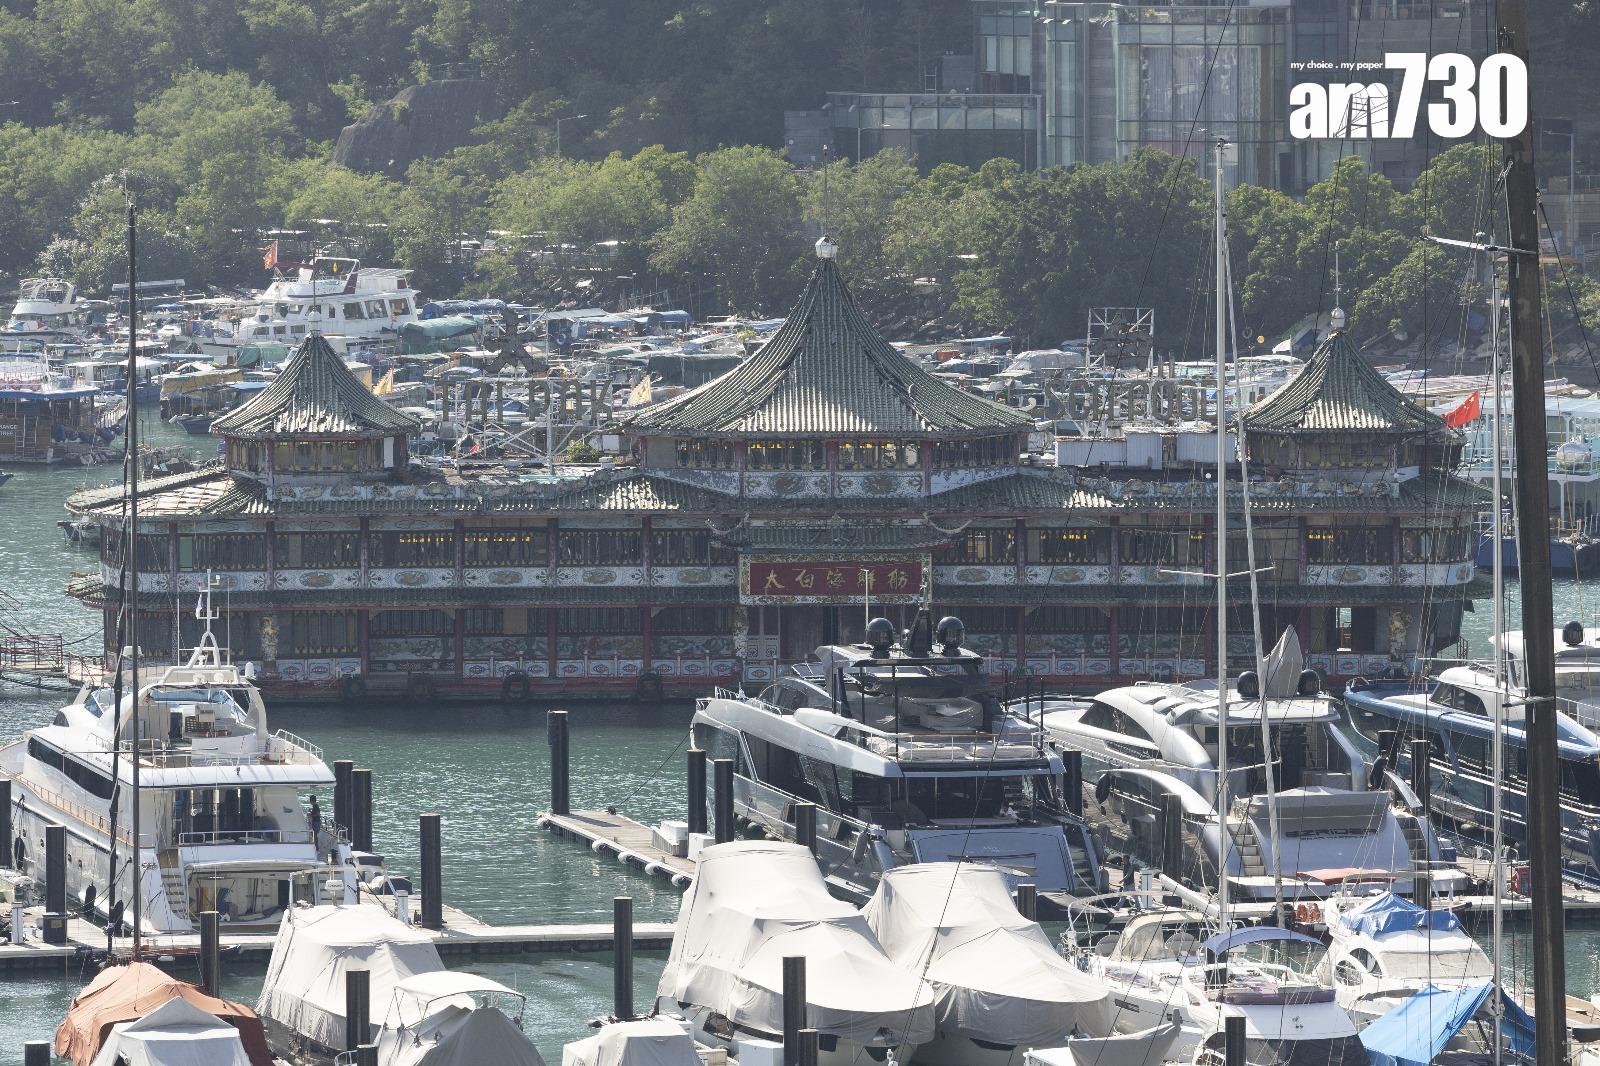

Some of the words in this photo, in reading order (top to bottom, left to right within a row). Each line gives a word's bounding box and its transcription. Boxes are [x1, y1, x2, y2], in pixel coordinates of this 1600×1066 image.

[764, 568, 909, 590] 太白海鮮舫
